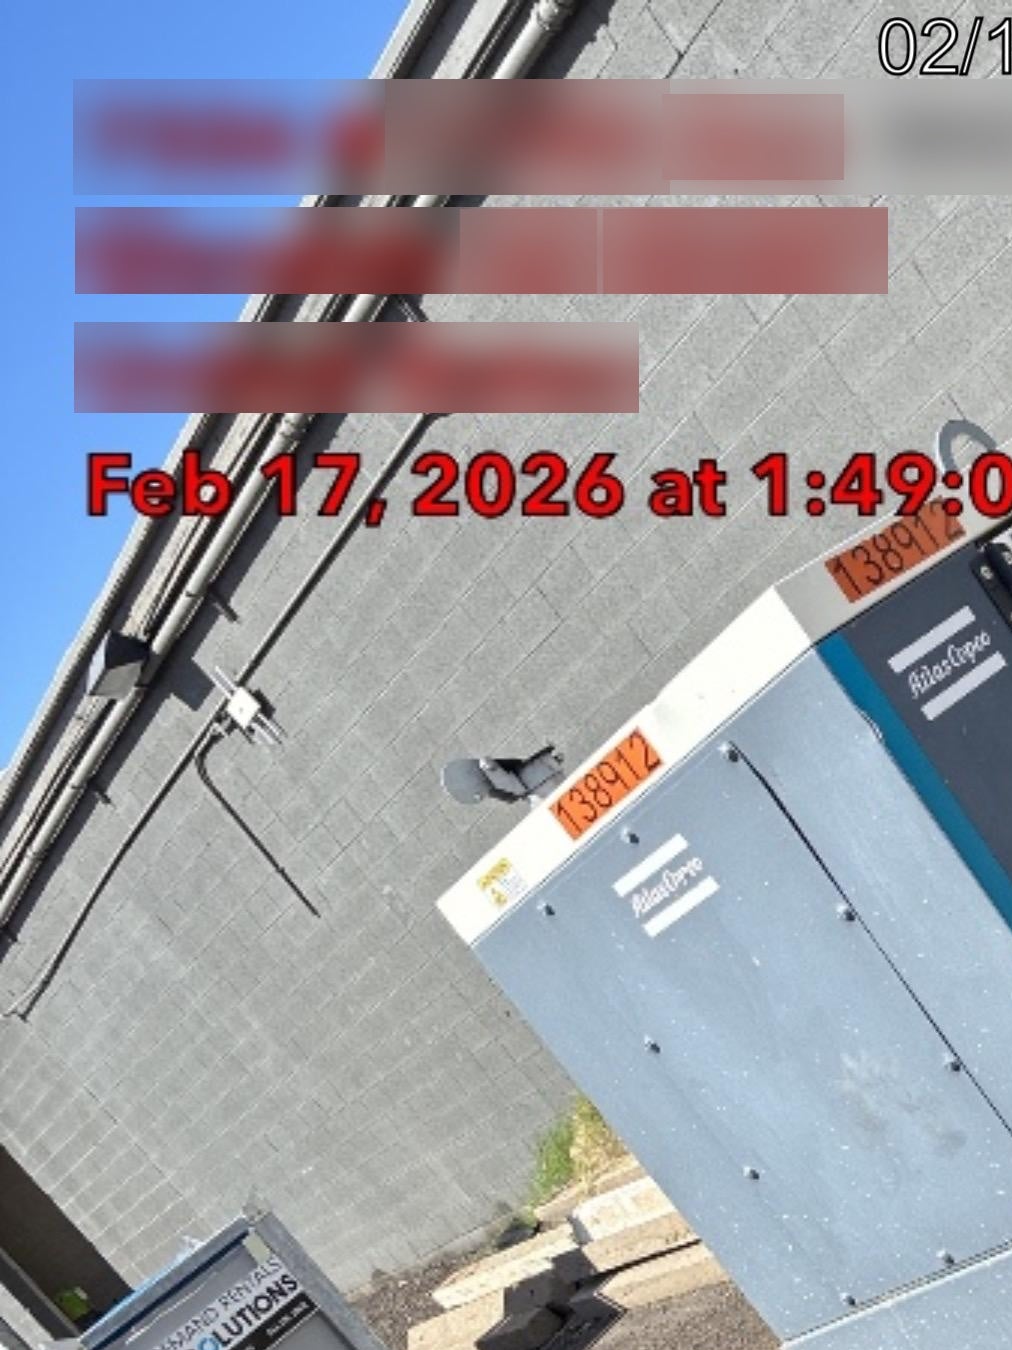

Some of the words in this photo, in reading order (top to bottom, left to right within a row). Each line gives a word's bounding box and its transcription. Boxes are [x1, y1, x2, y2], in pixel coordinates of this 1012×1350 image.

[832, 497, 966, 596] 138912
[556, 728, 662, 835] 138912
[218, 1257, 283, 1308] RENTALS
